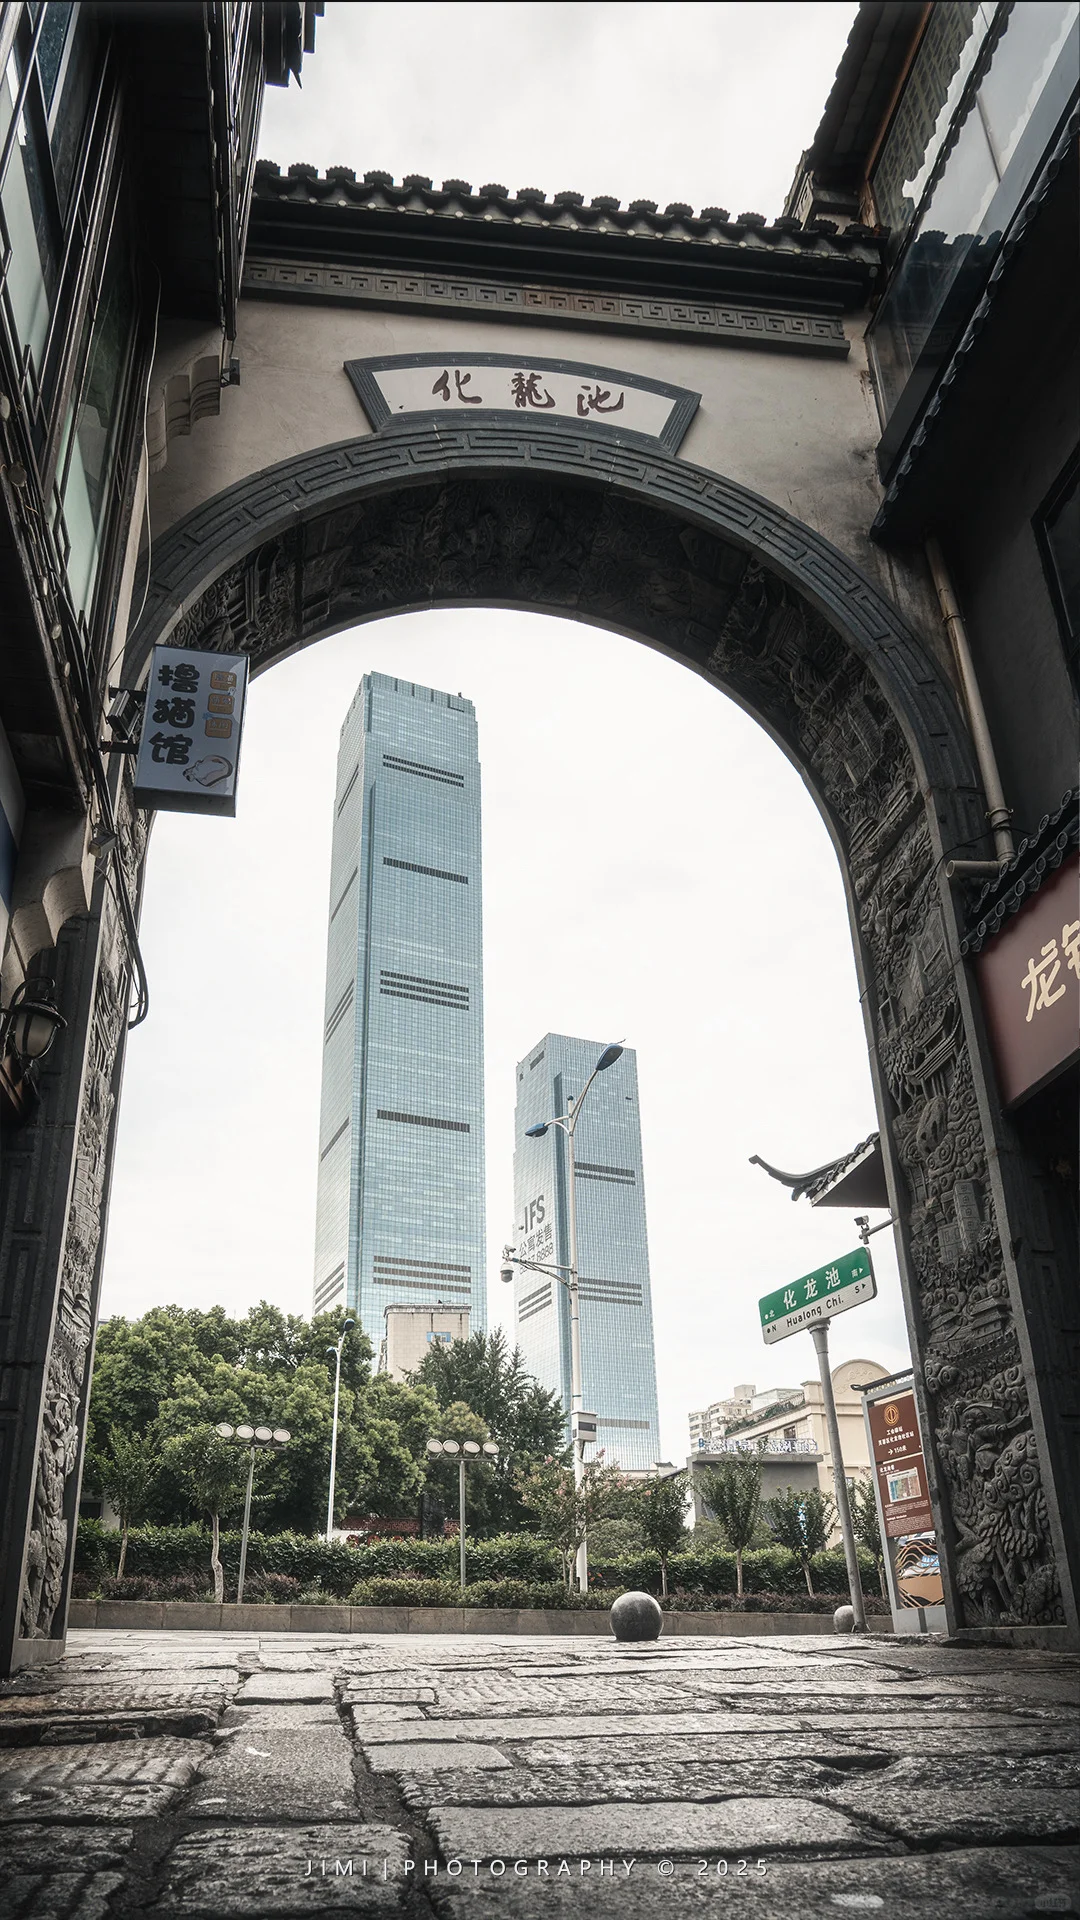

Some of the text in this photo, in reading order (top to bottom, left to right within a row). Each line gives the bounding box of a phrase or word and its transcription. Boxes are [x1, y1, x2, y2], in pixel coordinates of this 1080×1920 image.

[432, 369, 625, 417] 化龍池
[524, 1194, 545, 1234] IFS
[783, 1266, 841, 1310] 化龙池
[851, 1269, 858, 1278] 南
[786, 1305, 822, 1328] Hualong
[855, 1285, 860, 1294] S
